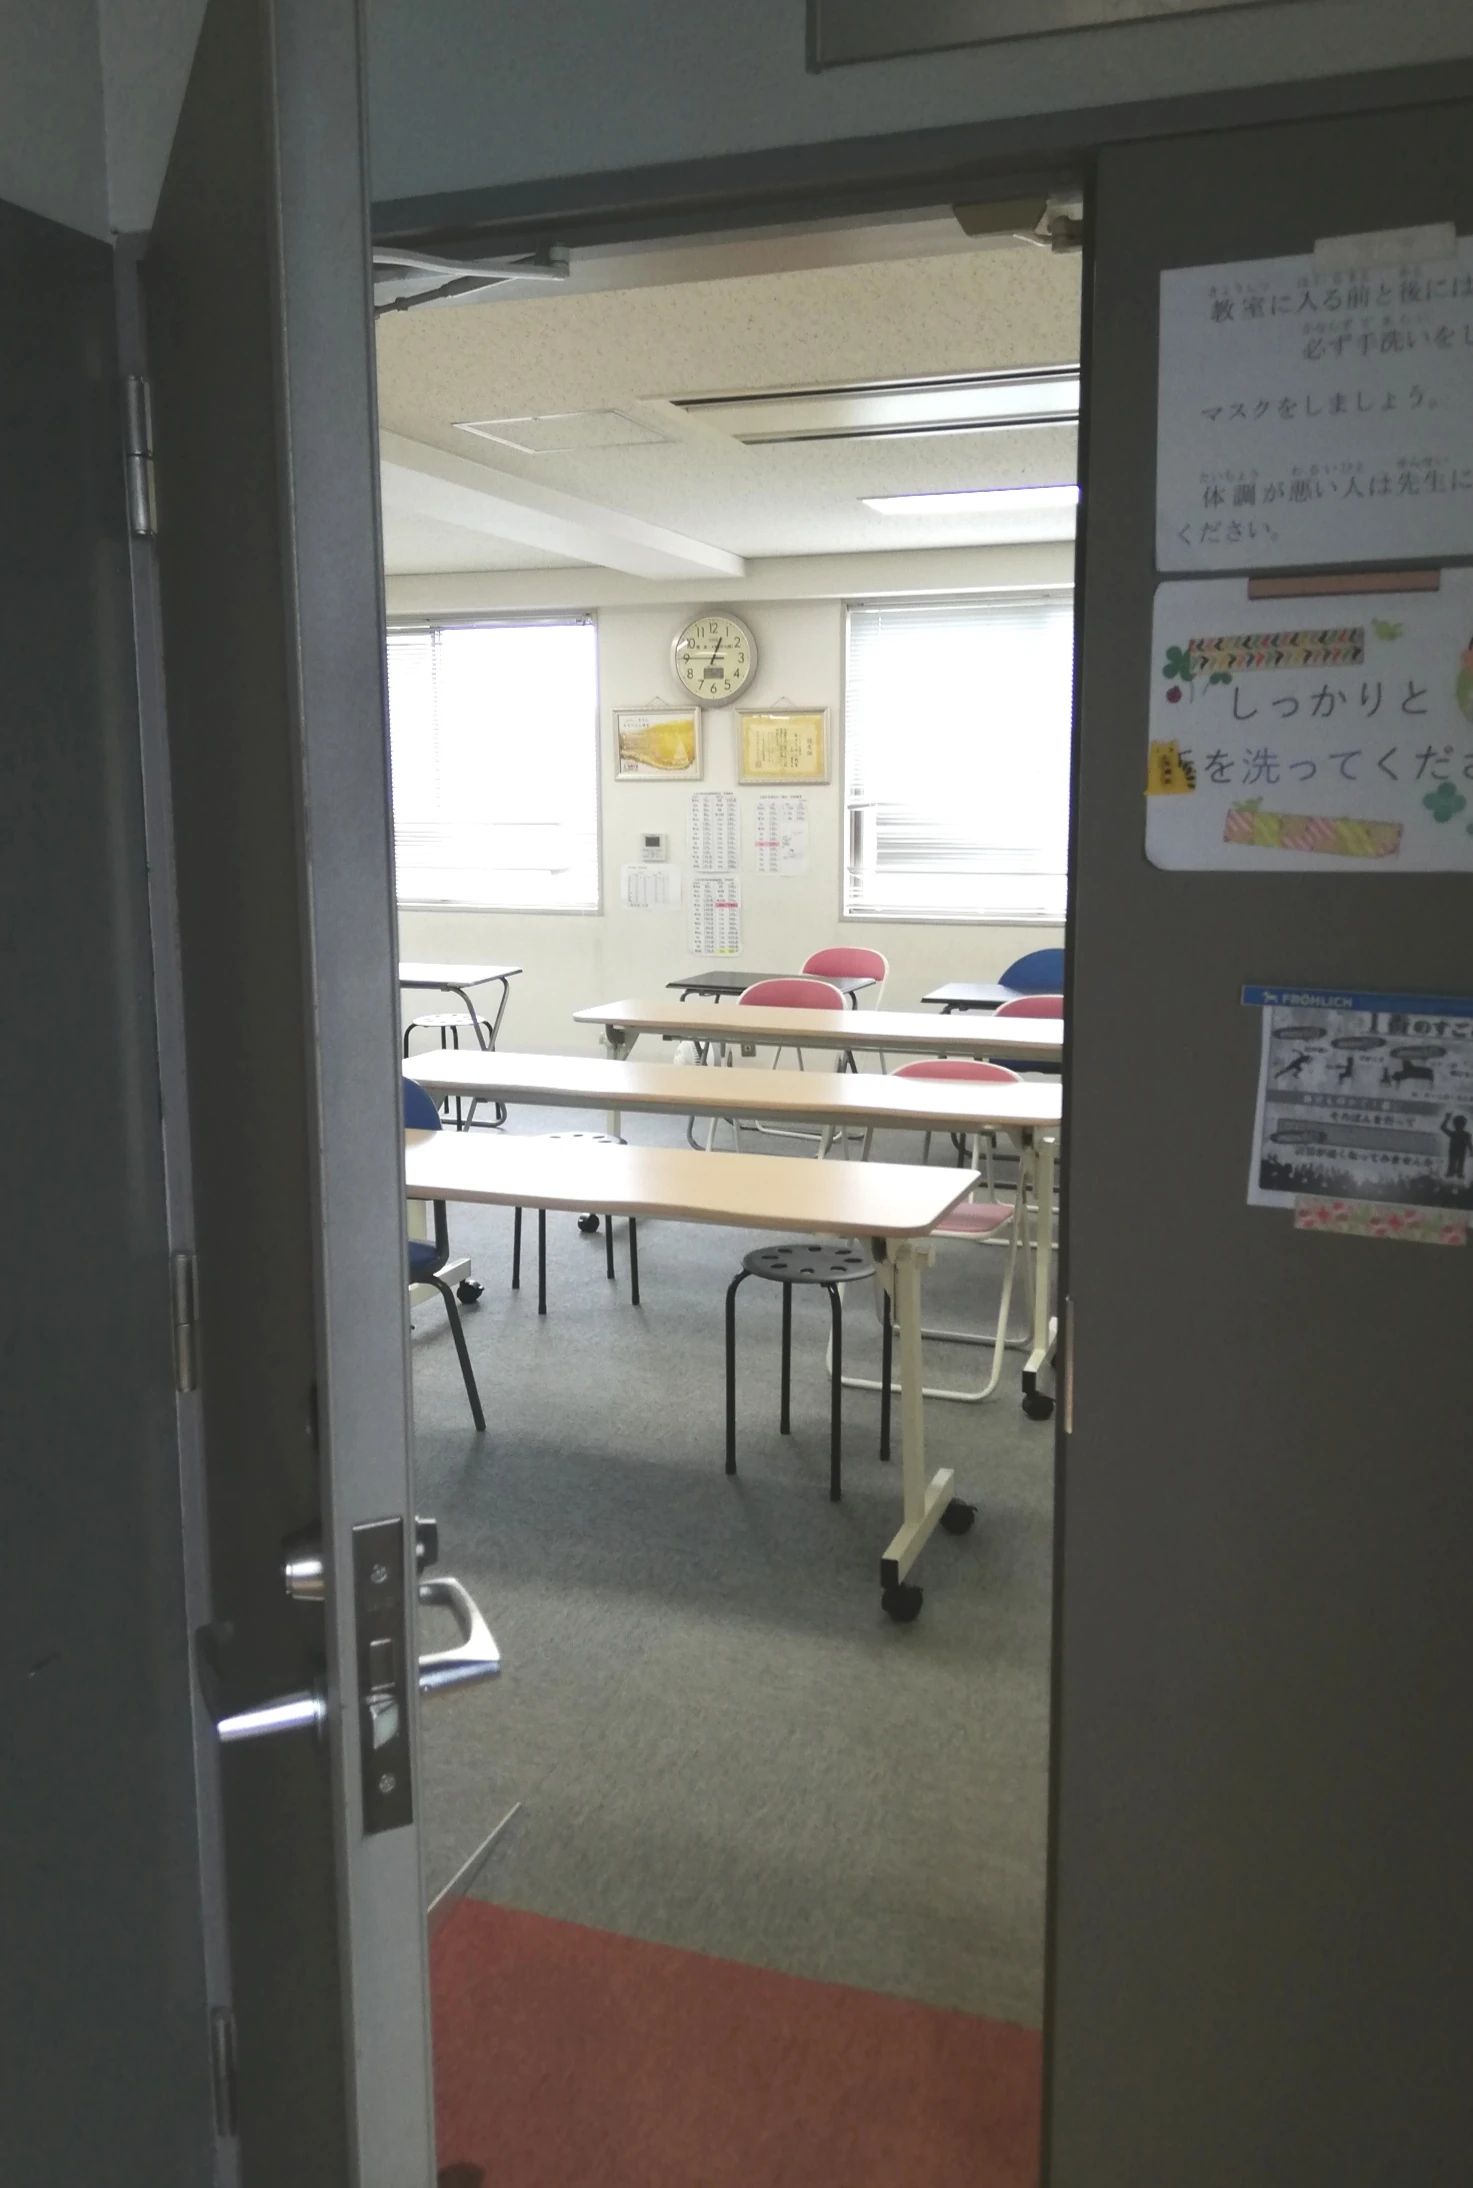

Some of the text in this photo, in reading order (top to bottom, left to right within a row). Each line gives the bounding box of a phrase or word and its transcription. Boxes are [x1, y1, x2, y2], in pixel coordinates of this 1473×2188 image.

[1202, 384, 1439, 421] マスクをしましょう。
[1177, 521, 1280, 546] ください。
[697, 627, 705, 638] 11
[709, 622, 718, 634] 12
[726, 626, 729, 637] 1
[734, 637, 741, 648] 2
[738, 652, 745, 663] 3
[687, 668, 694, 679] 8
[734, 668, 740, 679] 4
[697, 679, 704, 690] 7
[710, 683, 717, 694] 6
[724, 679, 731, 690] 5
[1232, 680, 1429, 721] しっかりと
